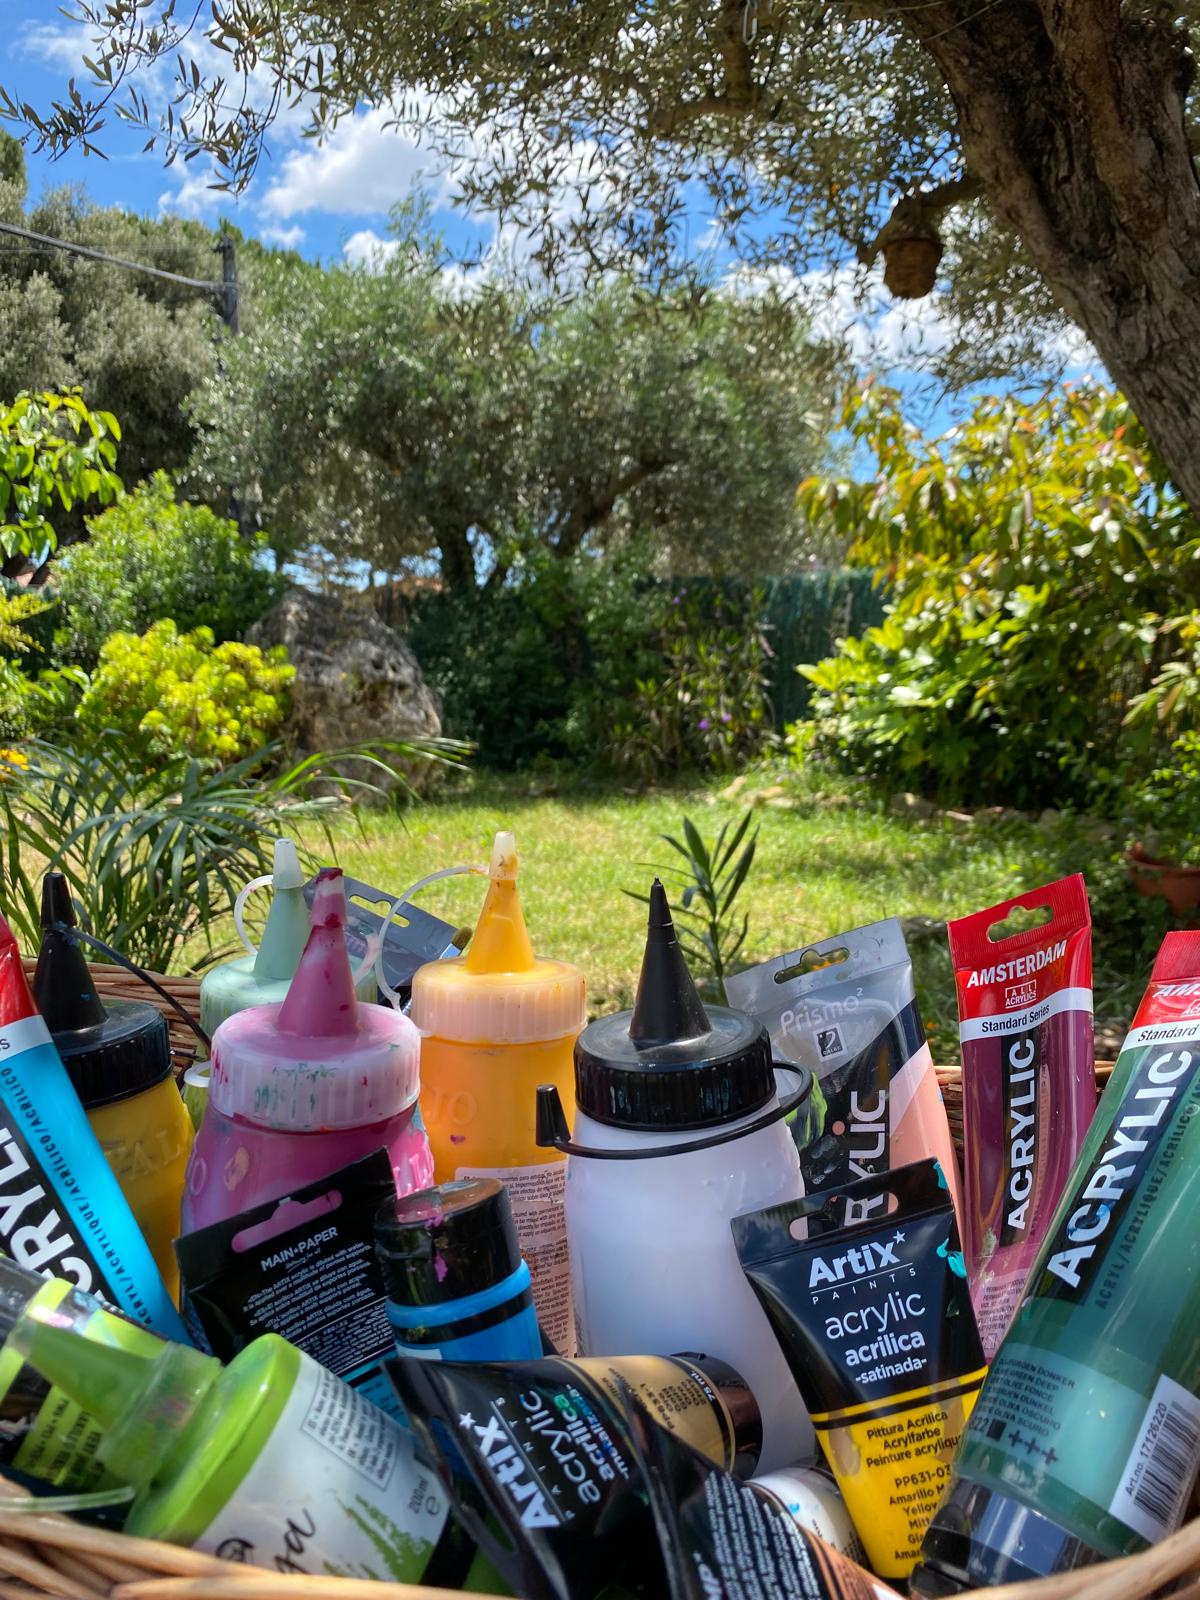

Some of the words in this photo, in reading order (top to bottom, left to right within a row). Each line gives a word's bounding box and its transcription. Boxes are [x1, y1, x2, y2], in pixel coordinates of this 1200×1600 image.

[967, 940, 1067, 988] AMSTERDAM
[1005, 990, 1036, 1007] ACRYLICS
[1011, 982, 1034, 997] ALL
[982, 1014, 1028, 1033] Standard
[1029, 1004, 1050, 1023] Series
[1138, 1023, 1200, 1042] Standard
[1008, 1038, 1035, 1230] ACRYLIC
[1047, 1050, 1192, 1288] ACRYLIC
[809, 1241, 900, 1288] Artix
[812, 1268, 916, 1305] PAINTS
[824, 1292, 926, 1340] acrylic
[845, 1330, 926, 1367] acrilica
[855, 1356, 927, 1384] -satinada-
[867, 1423, 904, 1440] Pittura
[906, 1411, 948, 1430] Acrilica
[883, 1426, 941, 1451] Acrylfarbe
[1140, 1402, 1168, 1459] 17126220
[519, 1390, 601, 1504] acrylic
[866, 1451, 912, 1468] Peinture
[915, 1435, 962, 1458] acryliqu
[473, 1415, 561, 1528] Artix
[889, 1489, 934, 1506] Amarillo
